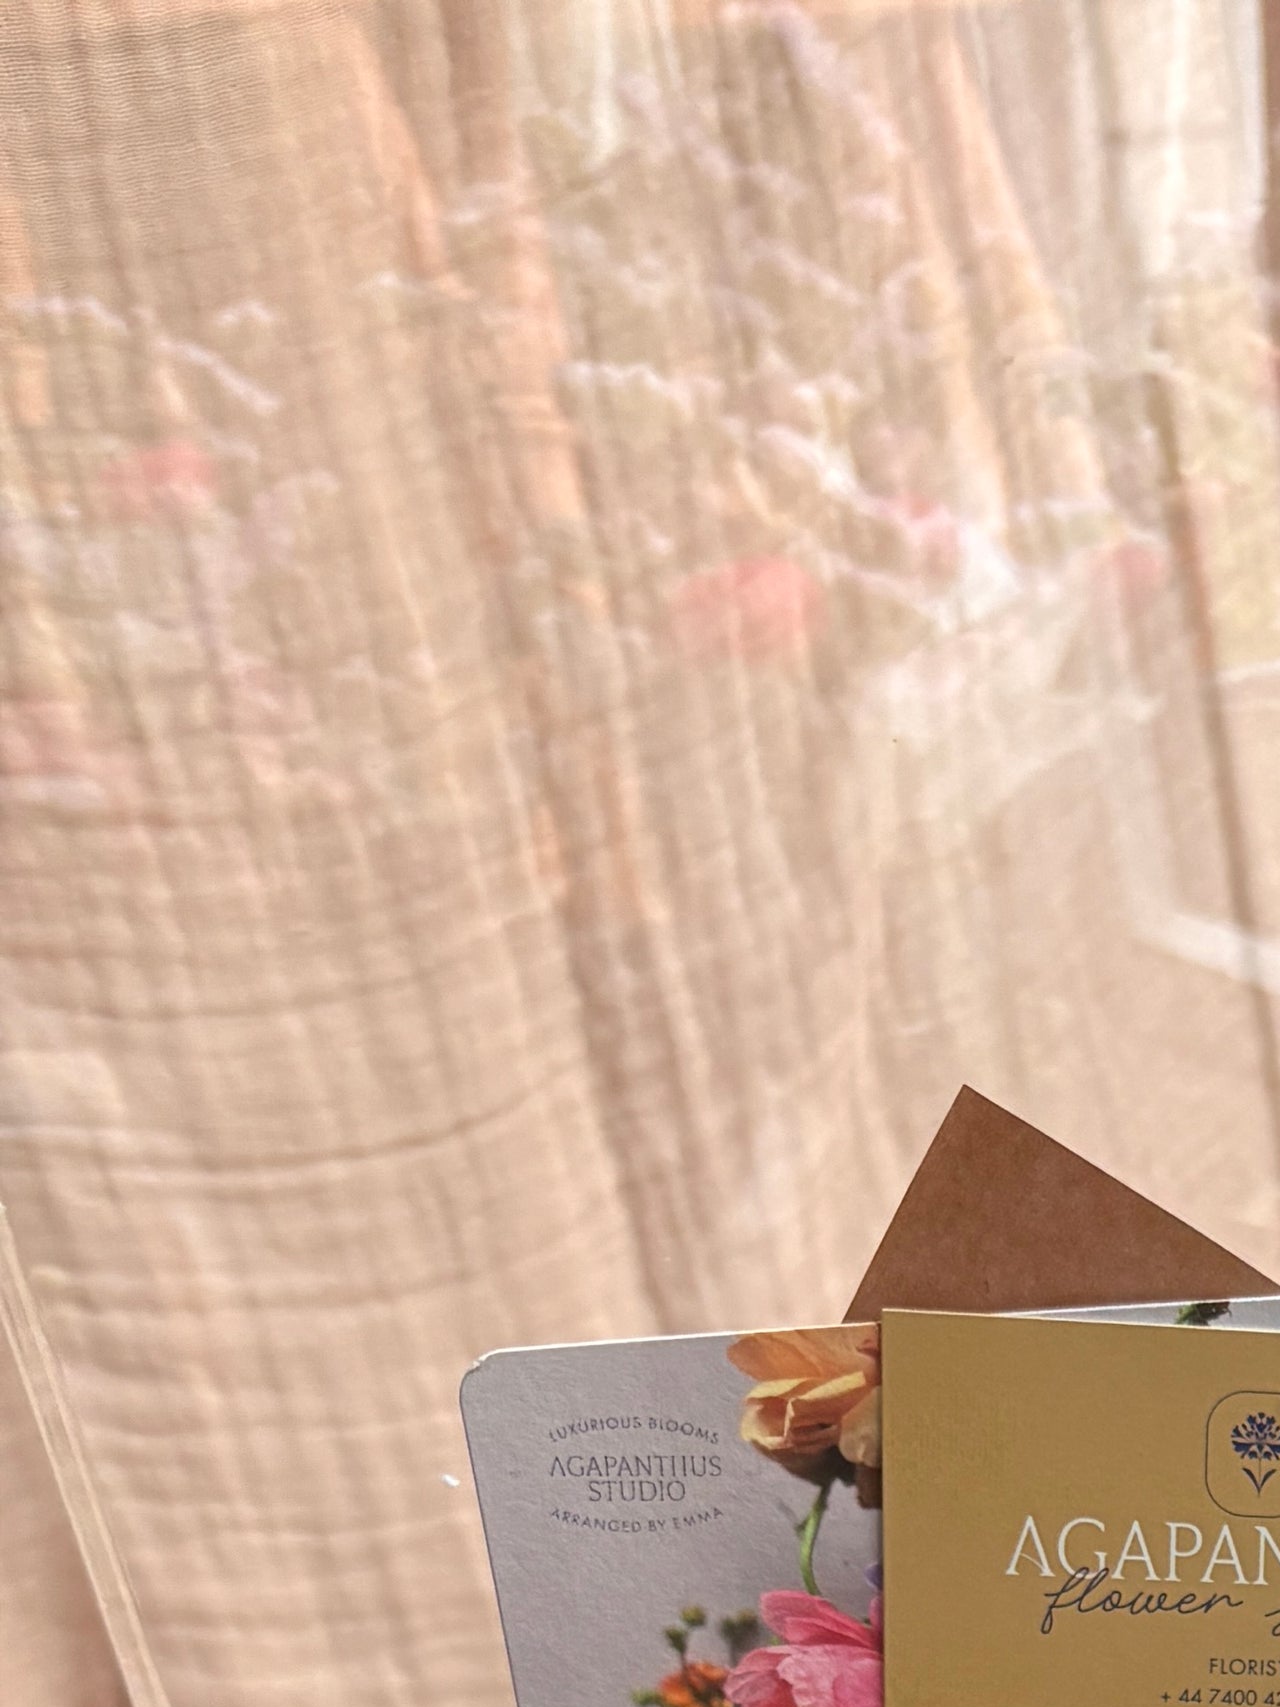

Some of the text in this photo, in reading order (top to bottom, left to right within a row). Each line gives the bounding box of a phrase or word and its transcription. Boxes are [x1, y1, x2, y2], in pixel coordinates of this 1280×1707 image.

[549, 1416, 719, 1444] LUXURIOUS BLOOMS
[550, 1455, 722, 1477] AGAPANTHUS
[588, 1480, 686, 1501] STUDIO
[551, 1507, 724, 1533] ARRANGED BY EMMA
[1040, 1567, 1244, 1635] flower
[1178, 1688, 1202, 1703] 44
[1208, 1688, 1257, 1706] 7400
